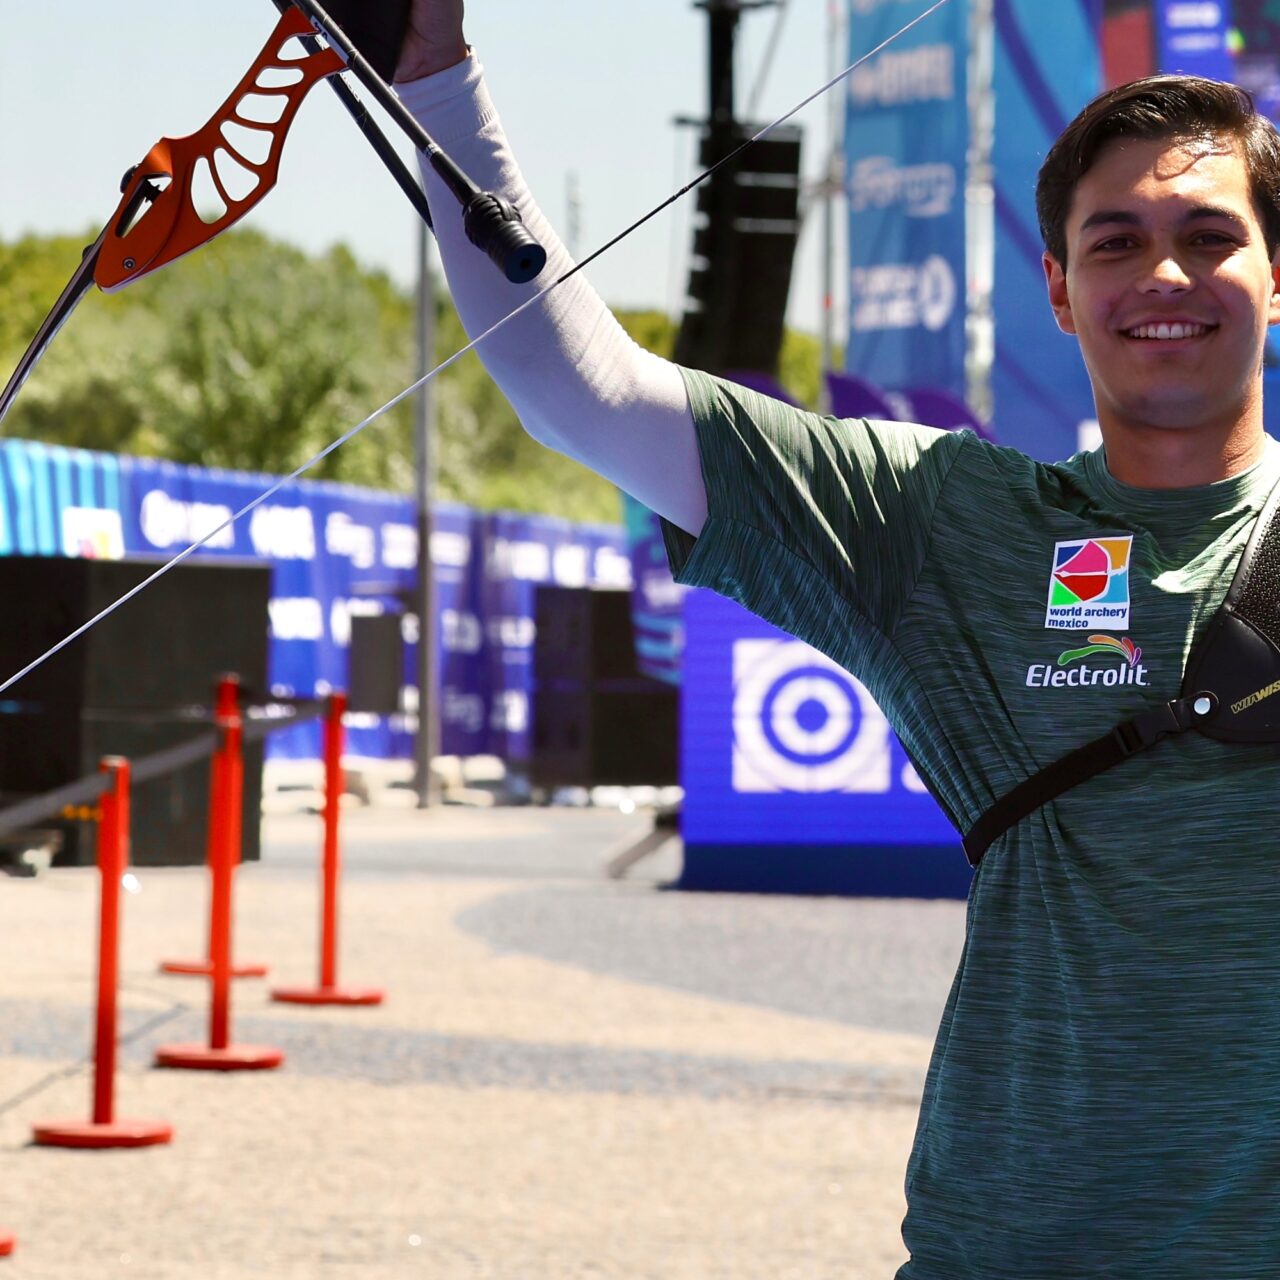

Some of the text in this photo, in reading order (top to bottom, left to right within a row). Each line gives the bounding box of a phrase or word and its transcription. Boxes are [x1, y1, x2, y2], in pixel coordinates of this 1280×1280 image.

[1049, 607, 1127, 618] world archery
[1047, 618, 1089, 628] mexico
[1025, 663, 1148, 688] Electrolit
